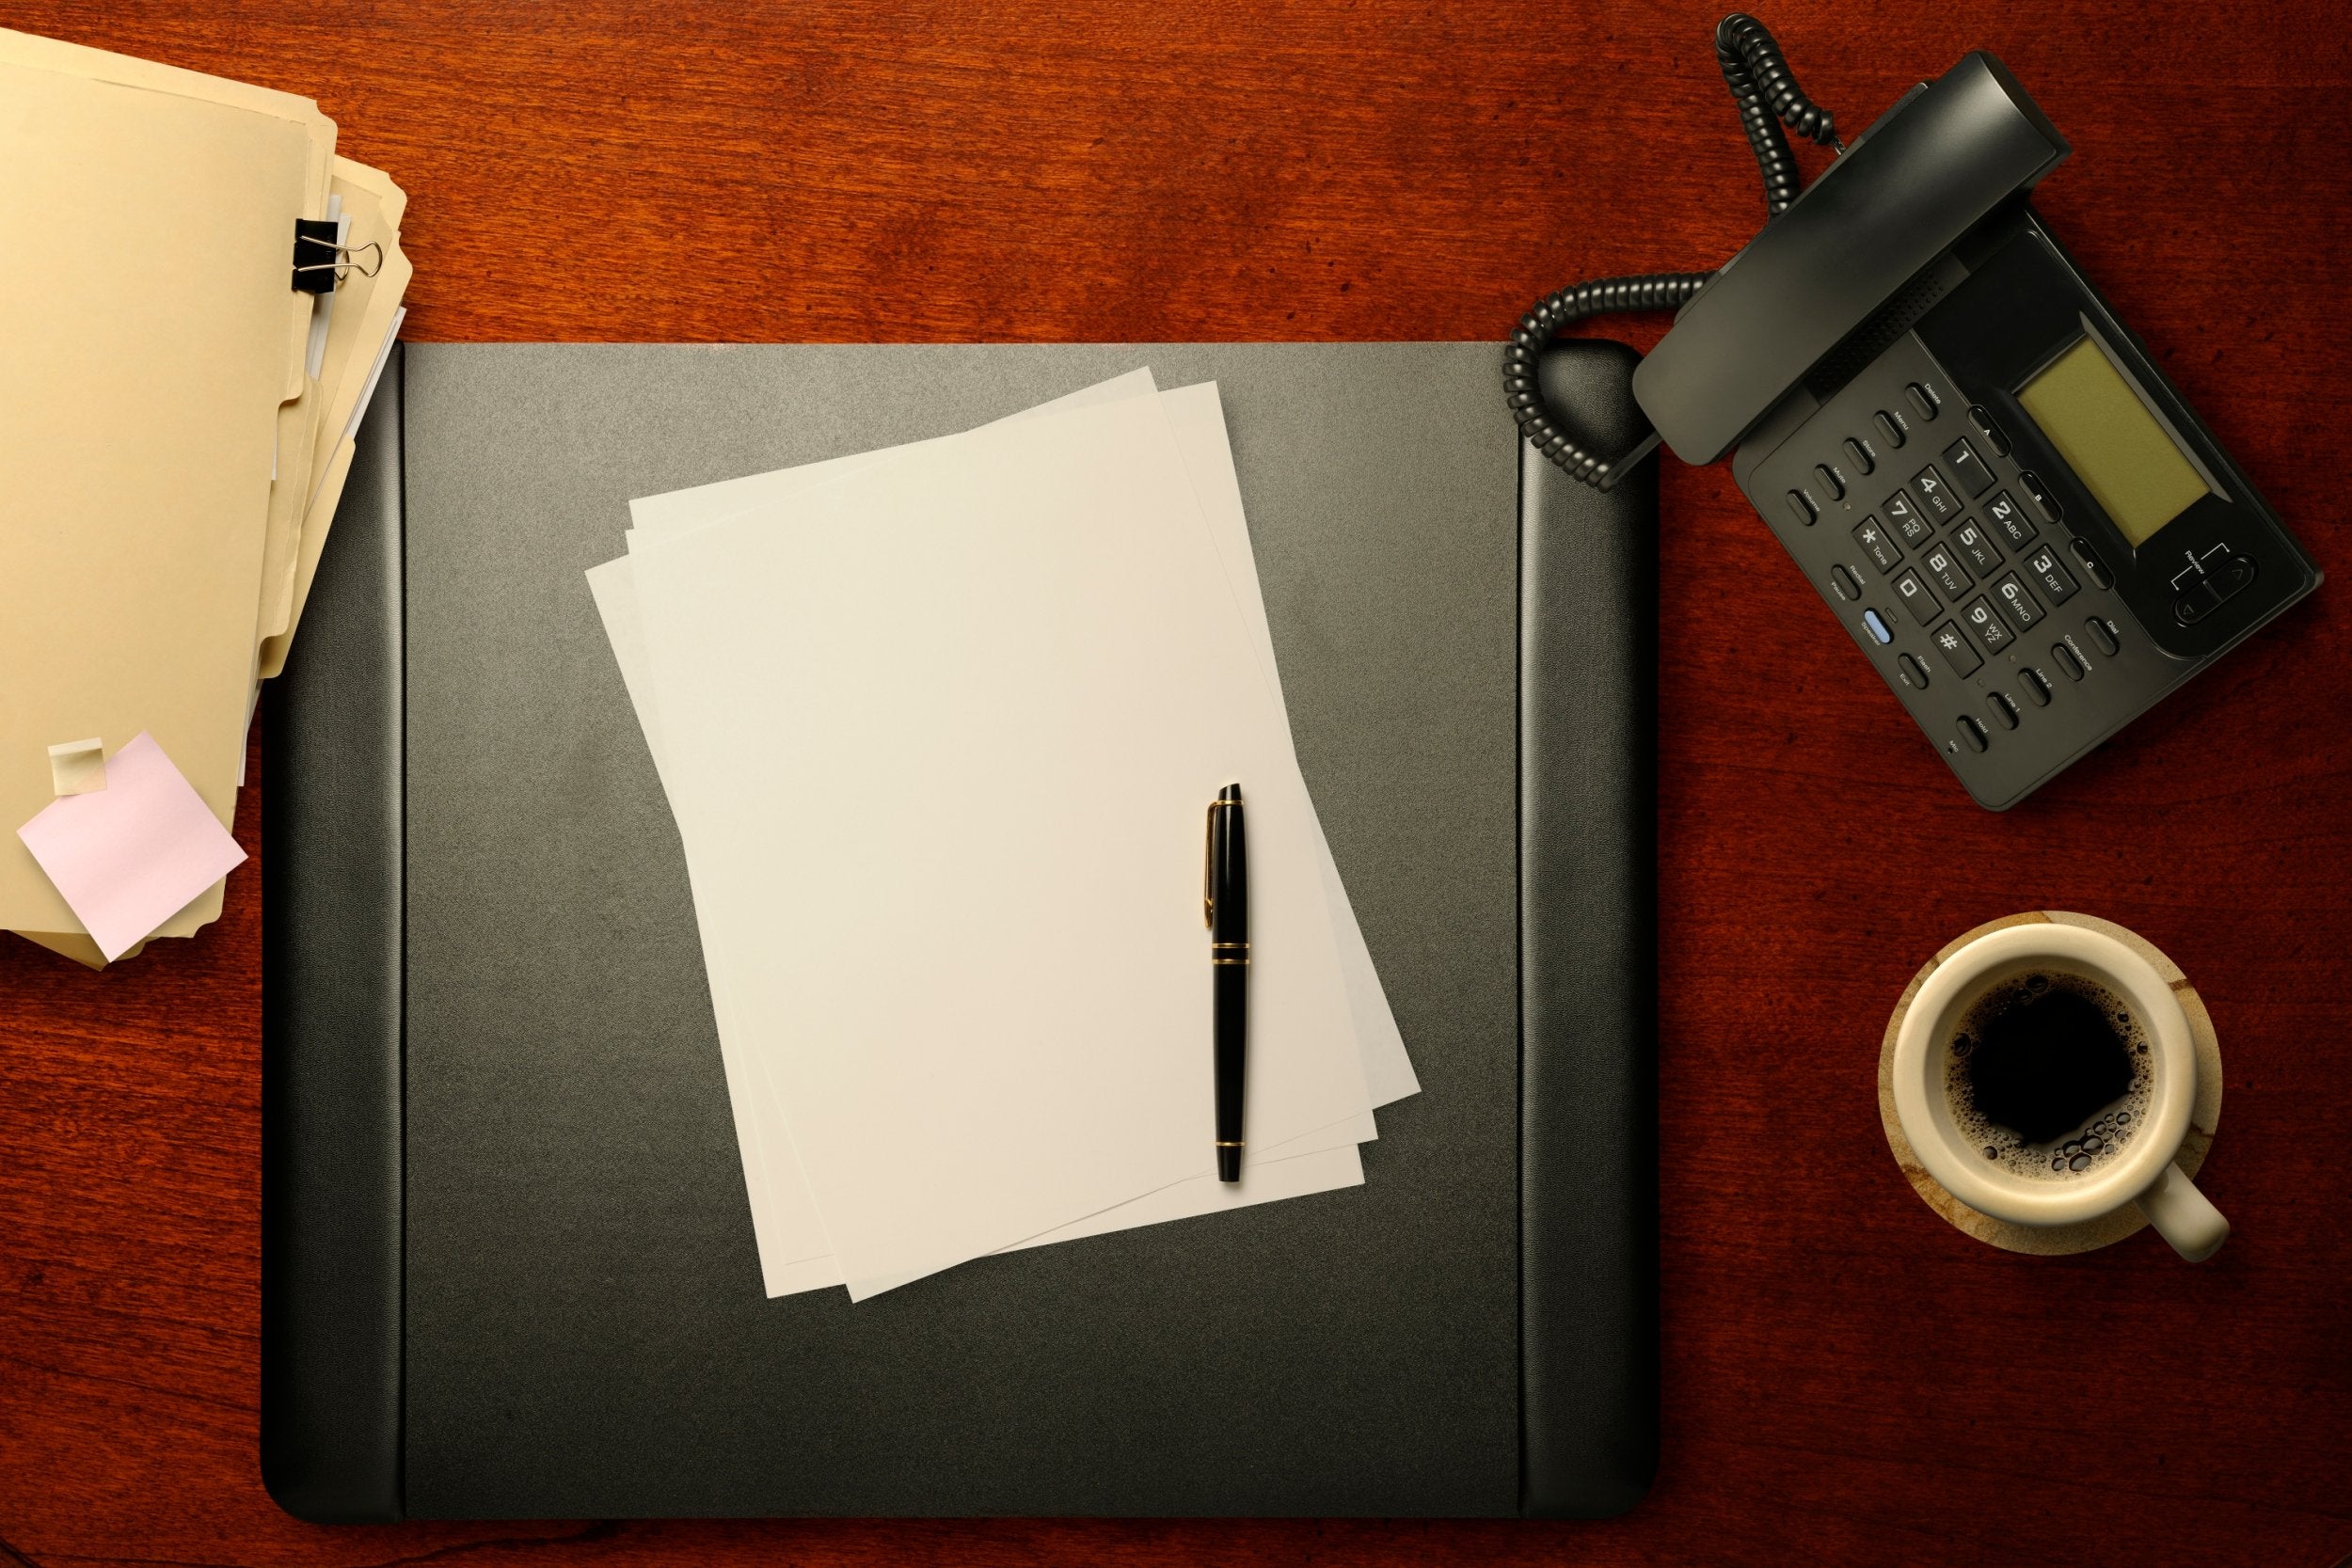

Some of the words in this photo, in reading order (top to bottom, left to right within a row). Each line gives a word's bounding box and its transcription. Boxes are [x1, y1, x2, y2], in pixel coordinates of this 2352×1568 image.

[1924, 383, 1941, 404] Delete
[1893, 411, 1909, 431] Menu
[1862, 440, 1876, 457] Store
[1956, 451, 1970, 464] 1
[1834, 467, 1846, 483] Mute
[1920, 478, 1937, 494] 4
[1804, 488, 1820, 512] Volume
[1932, 496, 1947, 513] GHI
[2034, 494, 2042, 502] B
[1891, 499, 1909, 515] 7
[1992, 500, 2011, 519] 2
[1901, 523, 1915, 538] RS
[1909, 518, 1921, 533] PQ
[2003, 520, 2022, 540] ABC
[1960, 527, 1978, 546] 5
[1873, 546, 1887, 565] Tone
[1929, 553, 1947, 573] 8
[1972, 548, 1987, 565] JKL
[2033, 554, 2052, 574] 3
[2185, 549, 2205, 575] Review
[1850, 564, 1866, 585] Redial
[1941, 572, 1958, 591] TUV
[1831, 581, 1846, 601] Pause
[1899, 578, 1917, 597] 0
[2001, 582, 2019, 600] 6
[2044, 574, 2063, 594] DEF
[1971, 607, 1988, 624] 9
[2010, 598, 2031, 622] MNO
[1861, 621, 1881, 646] Speaker
[1984, 628, 1996, 644] YZ
[1989, 623, 2003, 641] WX
[2106, 620, 2120, 635] Dial
[1940, 633, 1958, 650] #
[2064, 634, 2093, 672] Conference
[1917, 656, 1931, 673] Flash
[1899, 673, 1911, 687] Exit
[2036, 668, 2048, 685] Line
[2004, 693, 2017, 709] Line
[1976, 718, 1989, 735] Hold
[1949, 740, 1959, 753] Mic
